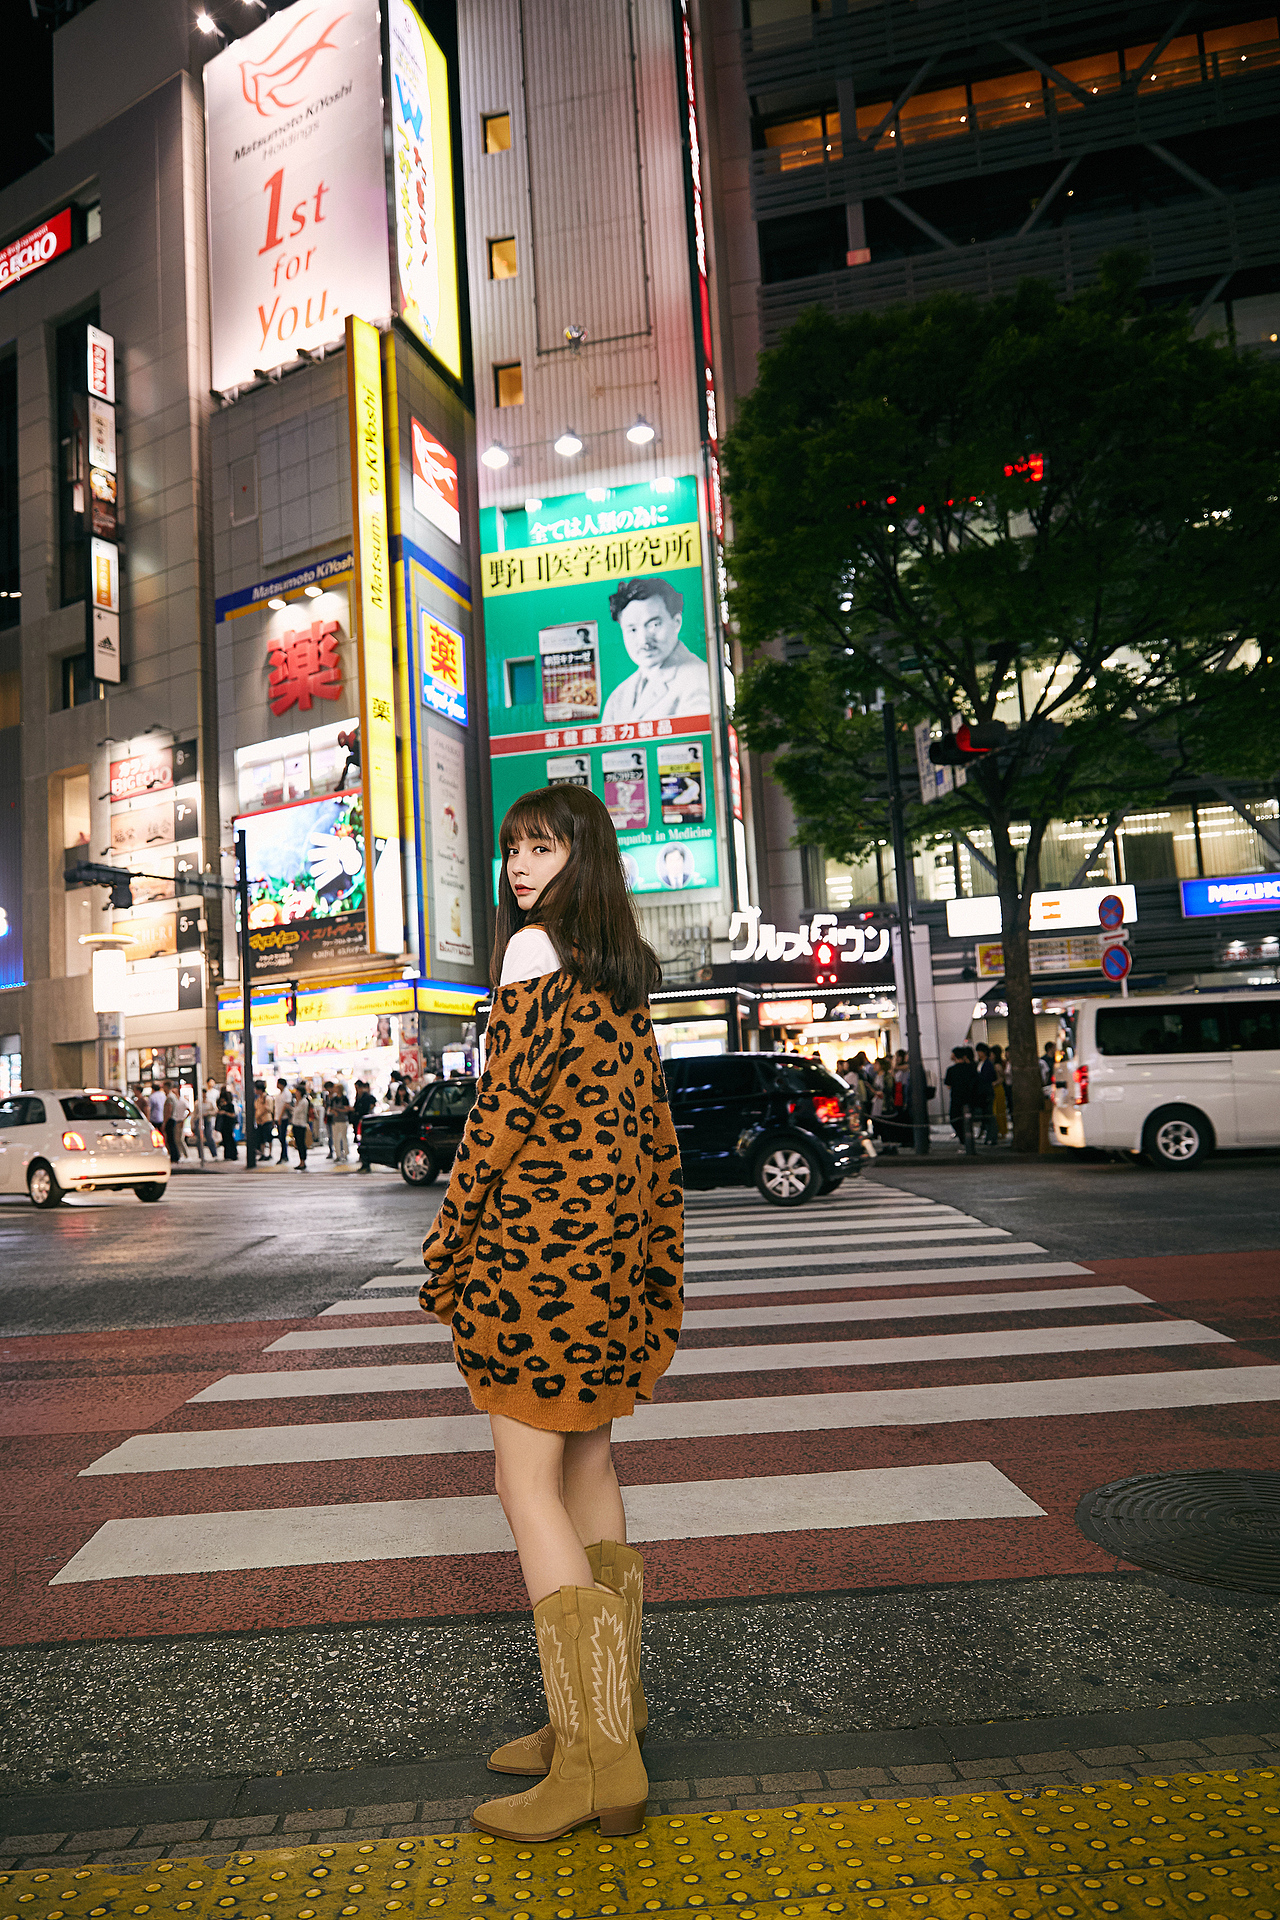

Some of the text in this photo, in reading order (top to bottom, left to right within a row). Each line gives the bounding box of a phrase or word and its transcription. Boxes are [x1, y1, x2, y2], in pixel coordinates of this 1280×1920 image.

[233, 79, 353, 163] Matsumoto KiYoshi
[262, 120, 320, 161] Holdings
[258, 167, 330, 256] 1st
[272, 245, 317, 288] for
[362, 384, 385, 610] Matsumo KiYoshi
[529, 504, 669, 545] 全ては人類の為に
[252, 553, 355, 601] Matsumoto KiYosh
[489, 529, 693, 589] 野口医学研究所
[266, 619, 345, 717] 薬
[429, 624, 457, 685] 薬
[372, 697, 391, 723] 薬
[111, 775, 136, 796] BIG
[617, 826, 712, 846] mpathy in Medicine
